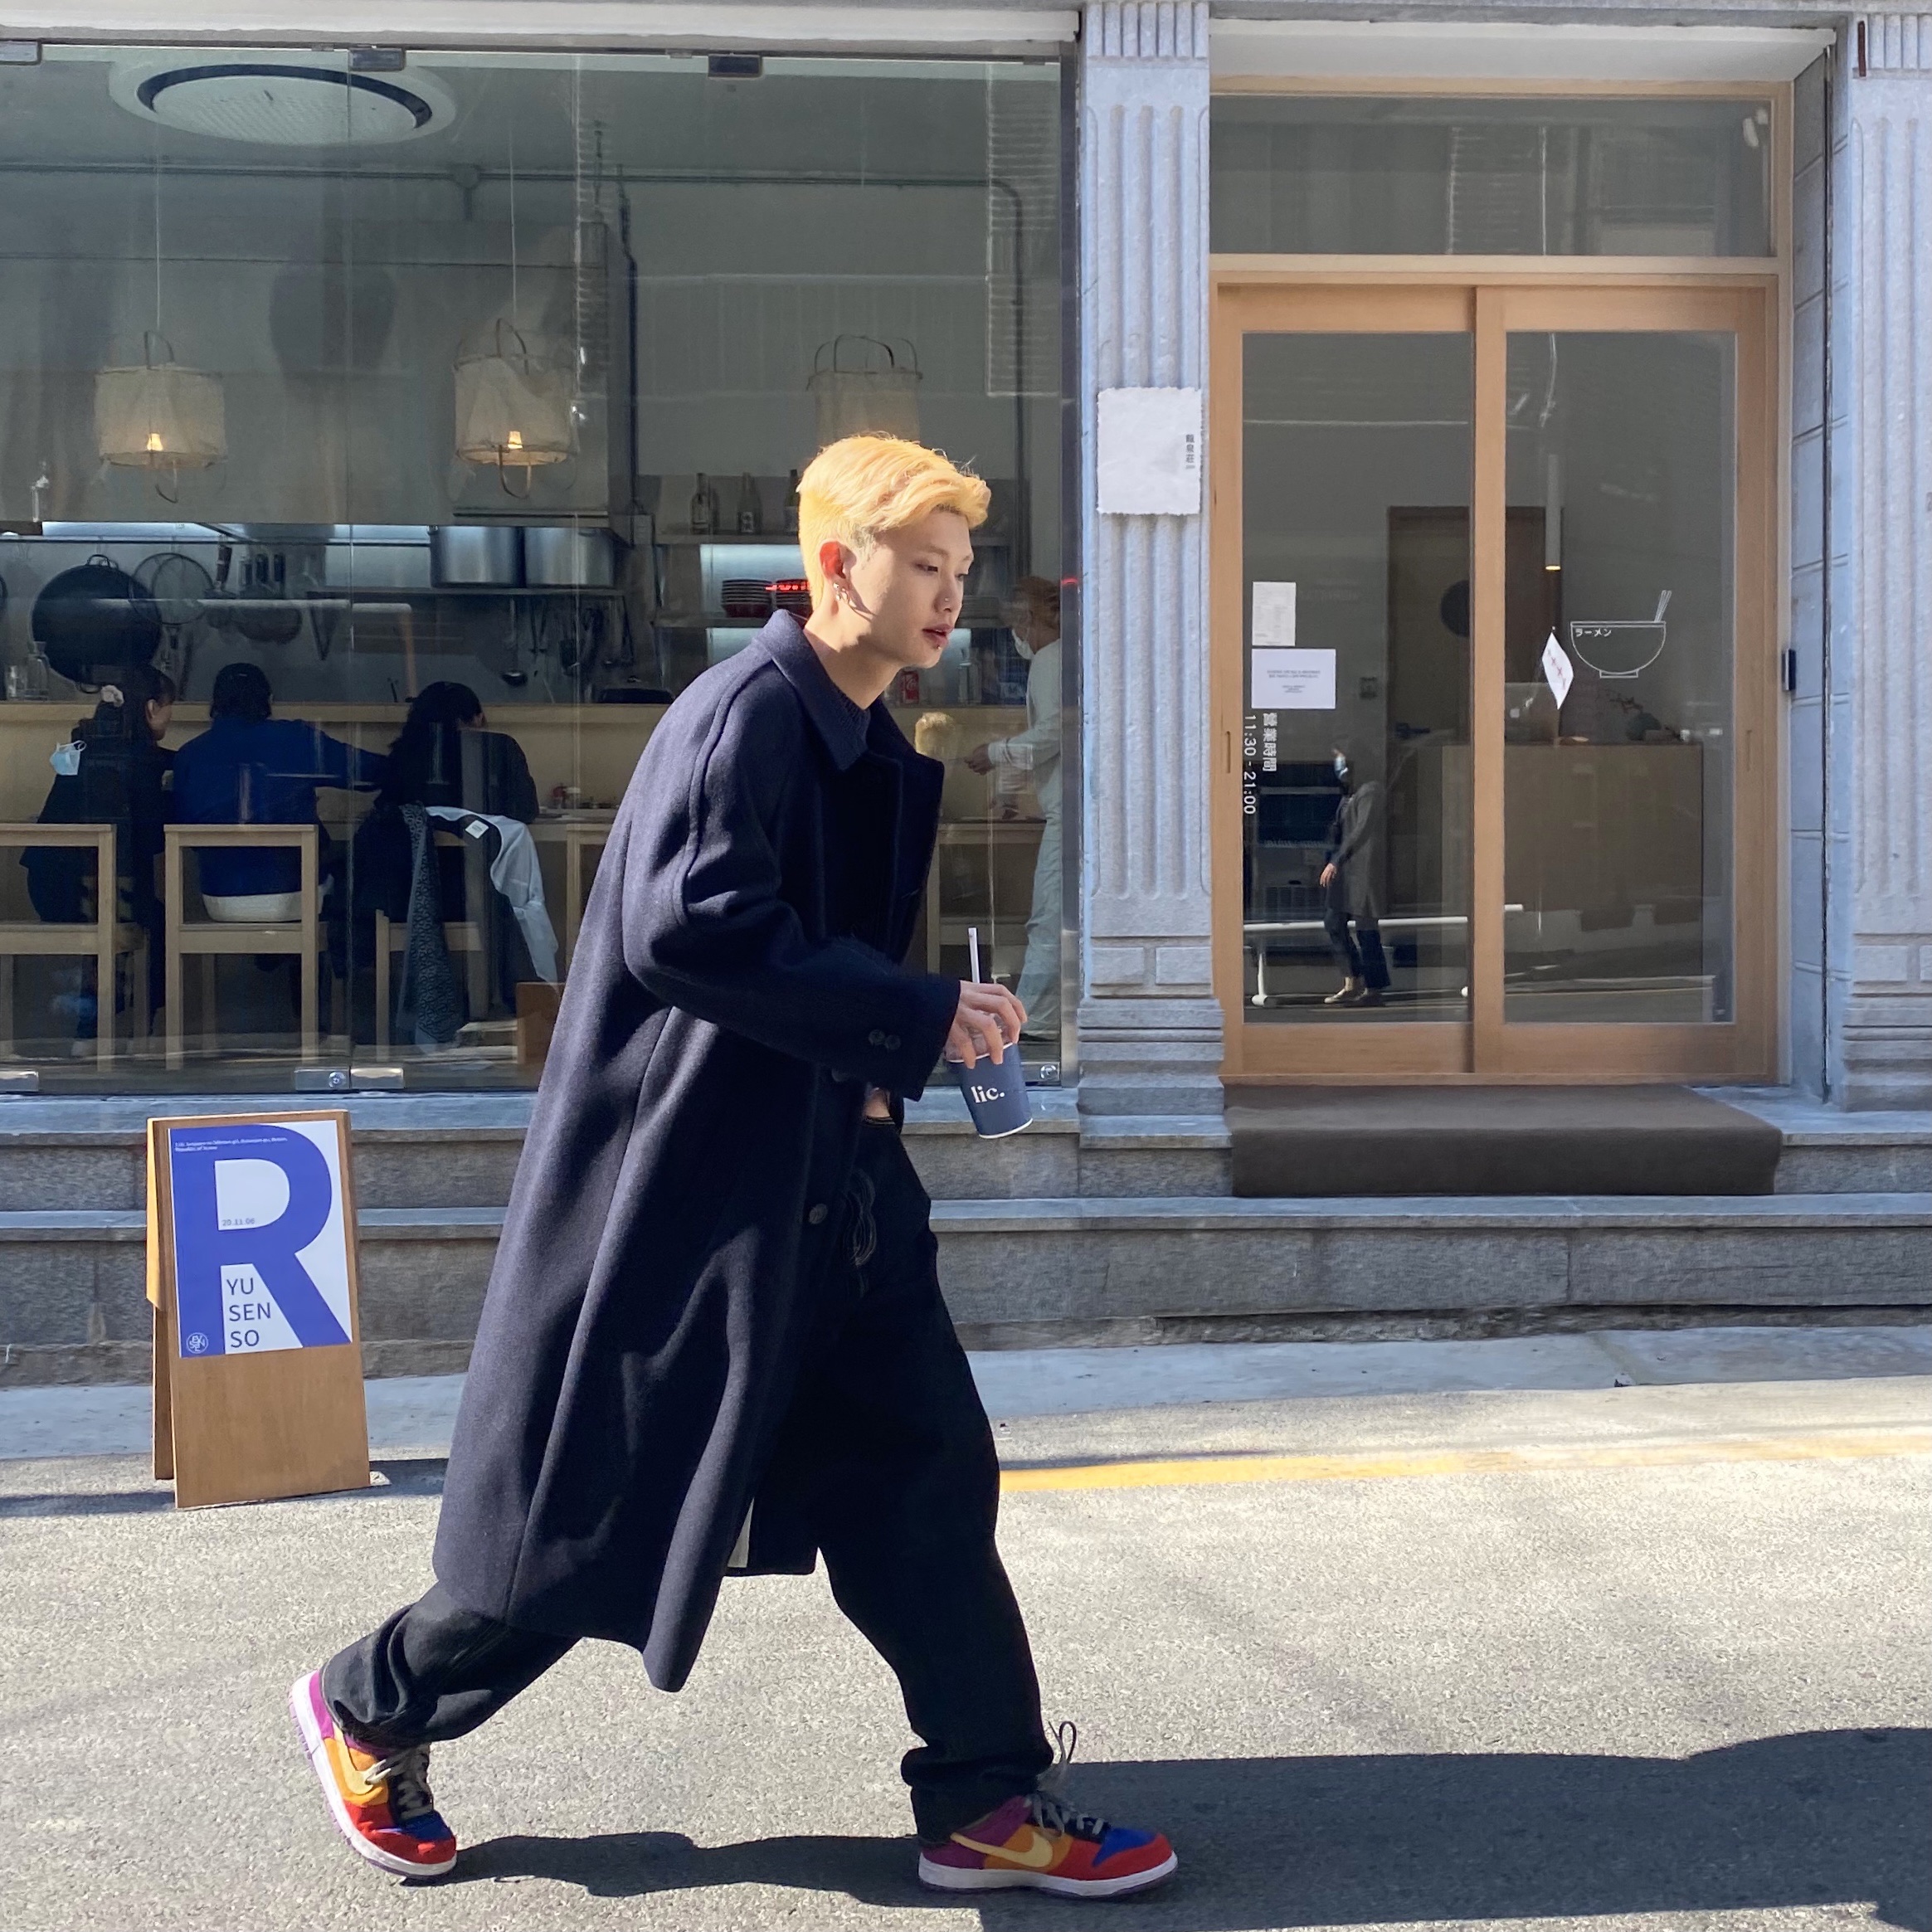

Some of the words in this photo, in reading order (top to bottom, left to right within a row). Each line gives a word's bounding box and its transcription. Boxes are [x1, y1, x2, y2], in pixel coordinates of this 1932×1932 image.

[1576, 628, 1612, 637] ラーメン
[1243, 715, 1257, 757] 11:30
[1243, 771, 1257, 815] 21:00
[971, 1085, 1005, 1103] lic.
[226, 1277, 254, 1296] YU
[229, 1302, 271, 1322] SEN
[230, 1329, 260, 1348] SO
